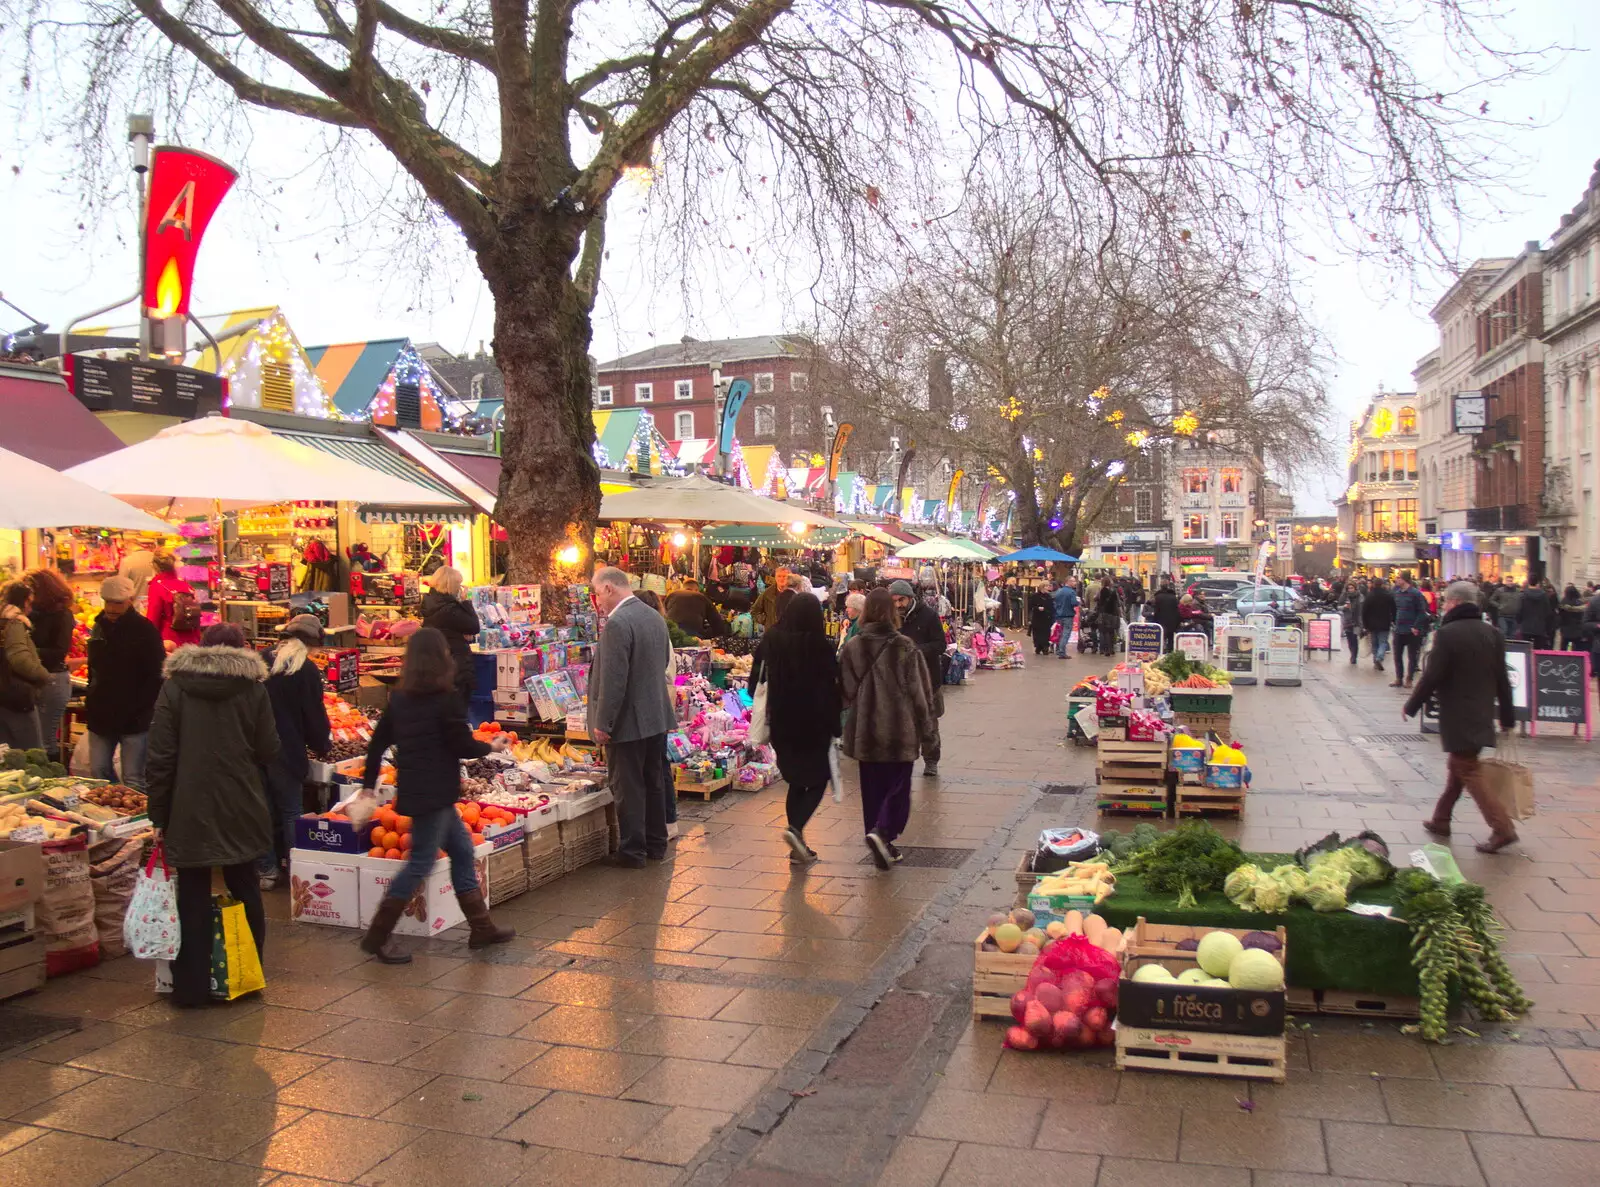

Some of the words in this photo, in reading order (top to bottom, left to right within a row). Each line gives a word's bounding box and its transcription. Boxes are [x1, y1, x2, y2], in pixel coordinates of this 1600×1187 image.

[156, 181, 197, 242] A
[728, 391, 742, 418] C
[1281, 541, 1288, 550] 7
[303, 908, 341, 919] WALNUTS
